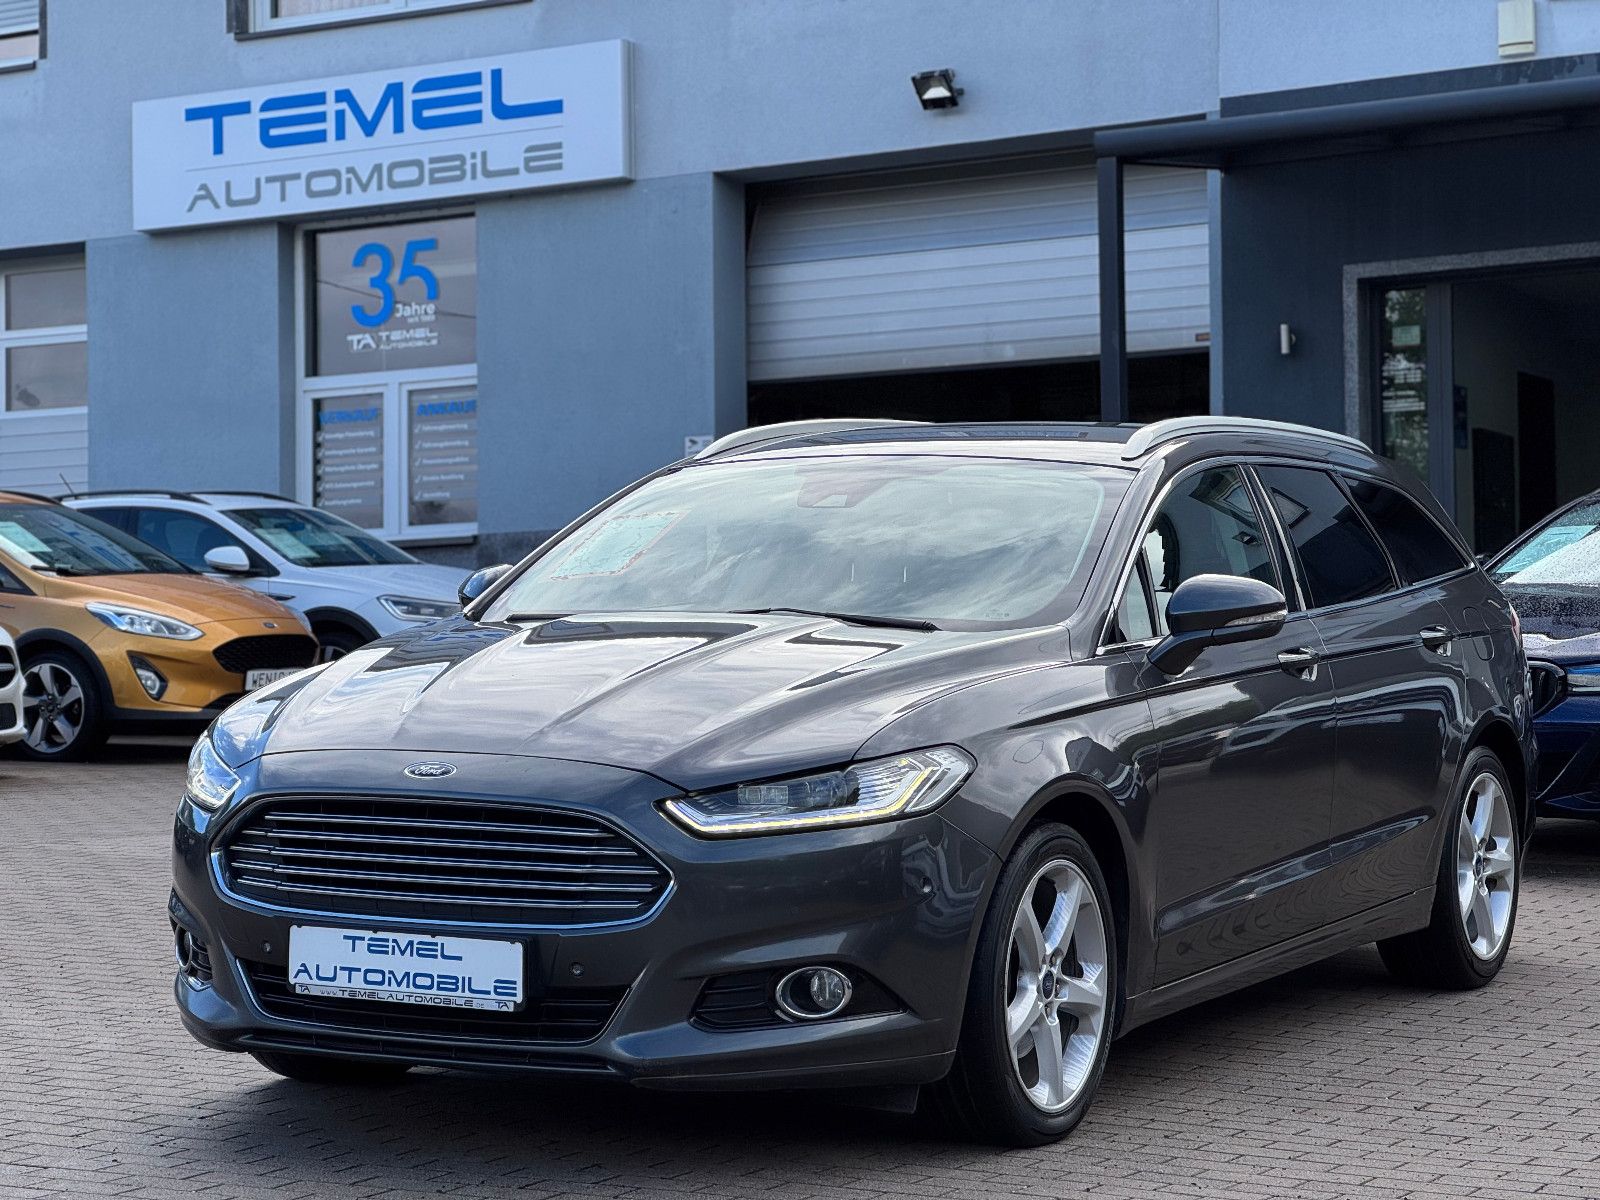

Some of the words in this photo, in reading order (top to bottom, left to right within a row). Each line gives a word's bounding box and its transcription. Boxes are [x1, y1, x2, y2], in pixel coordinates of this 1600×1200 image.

[184, 68, 564, 156] TEMEL
[351, 238, 439, 328] 35
[395, 302, 436, 318] Jahre
[346, 333, 376, 351] TA
[378, 328, 438, 341] TEMEL
[342, 934, 463, 961] TEMEL
[293, 962, 517, 998] AUTOMOBILE
[298, 985, 311, 993] TA
[494, 1001, 510, 1010] TA
